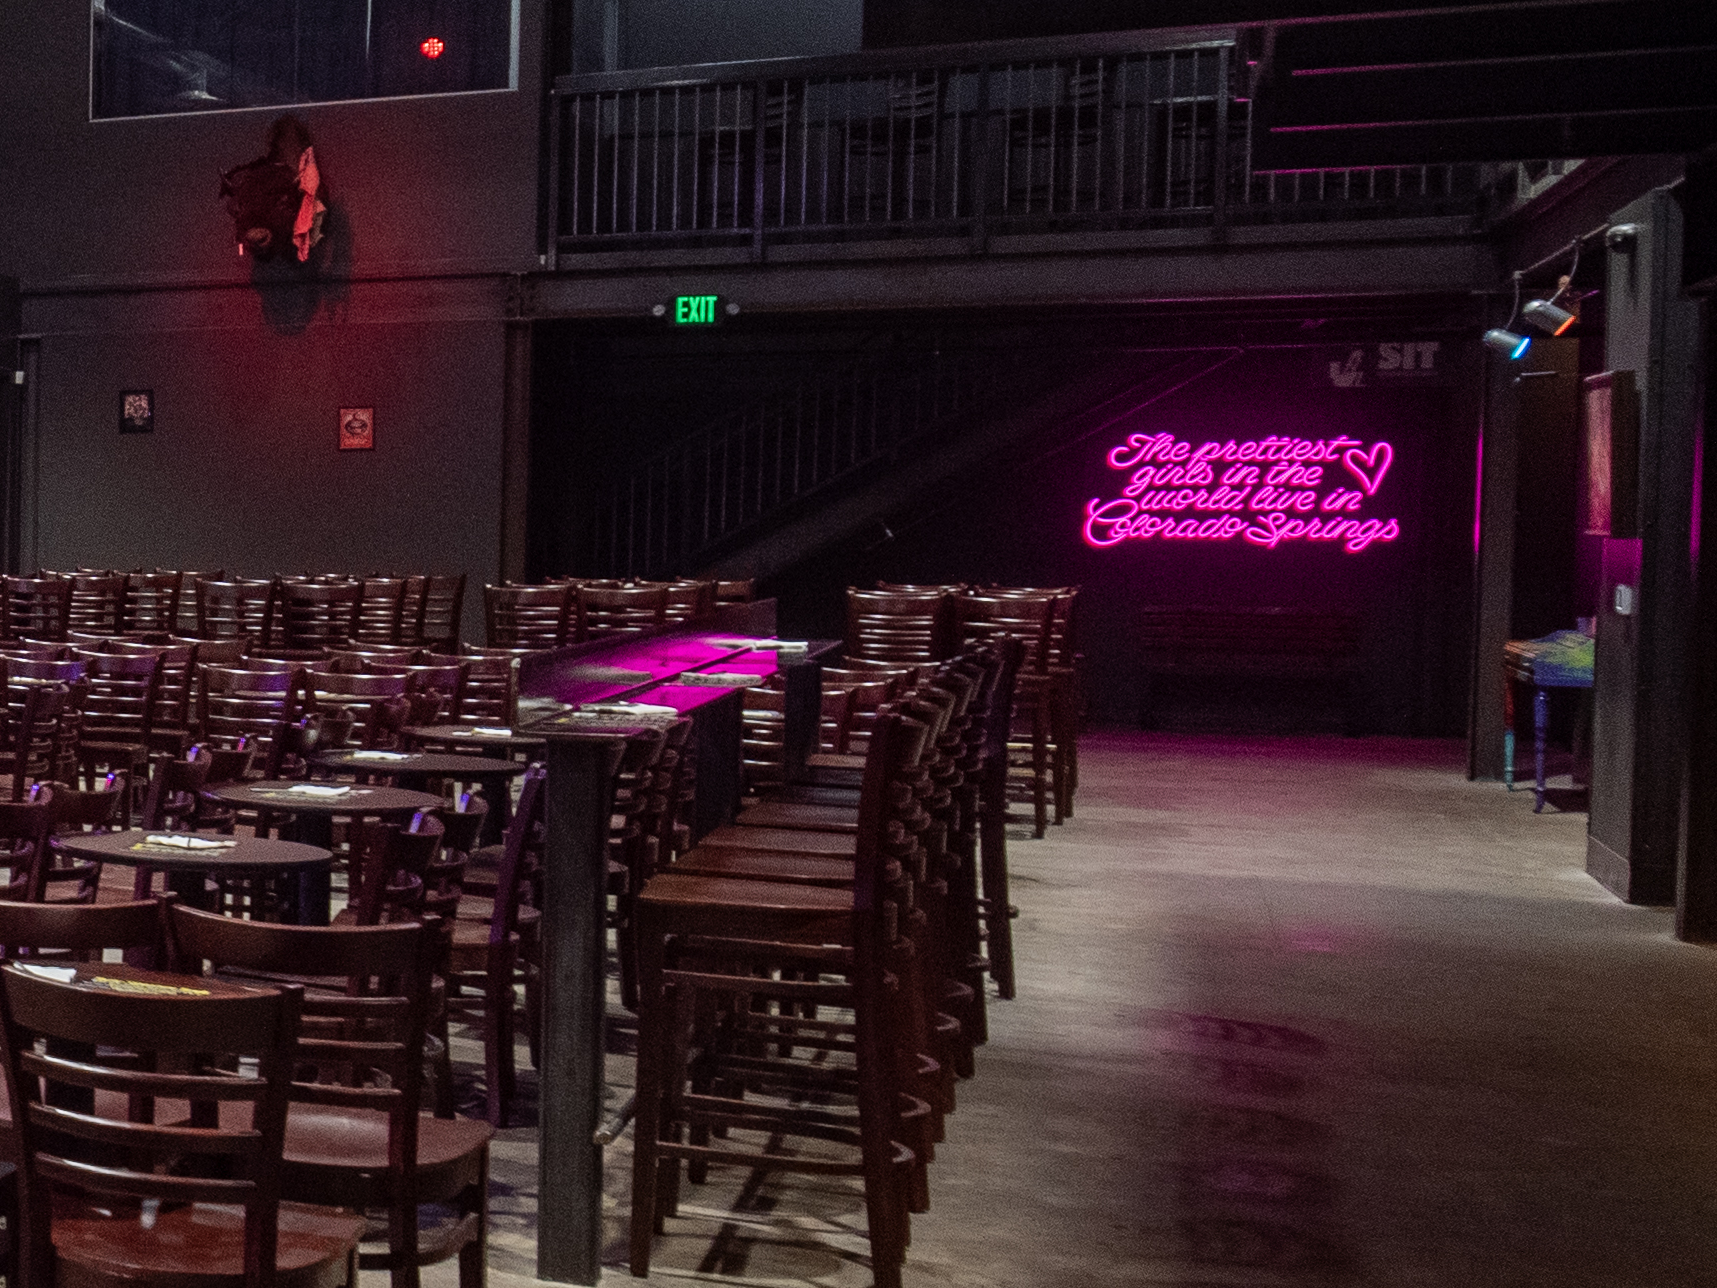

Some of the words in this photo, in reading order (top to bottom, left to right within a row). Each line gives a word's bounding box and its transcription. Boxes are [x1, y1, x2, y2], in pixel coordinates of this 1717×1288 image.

[676, 296, 718, 323] EXIT
[1107, 432, 1191, 468] The
[1187, 434, 1363, 470] prettiest
[1123, 461, 1214, 496] girls
[1220, 462, 1261, 486] in
[1265, 460, 1324, 485] the
[1139, 485, 1252, 511] world
[1251, 486, 1317, 512] live
[1322, 488, 1364, 512] in
[1083, 498, 1250, 548] Colorado
[1244, 512, 1401, 553] Springs
